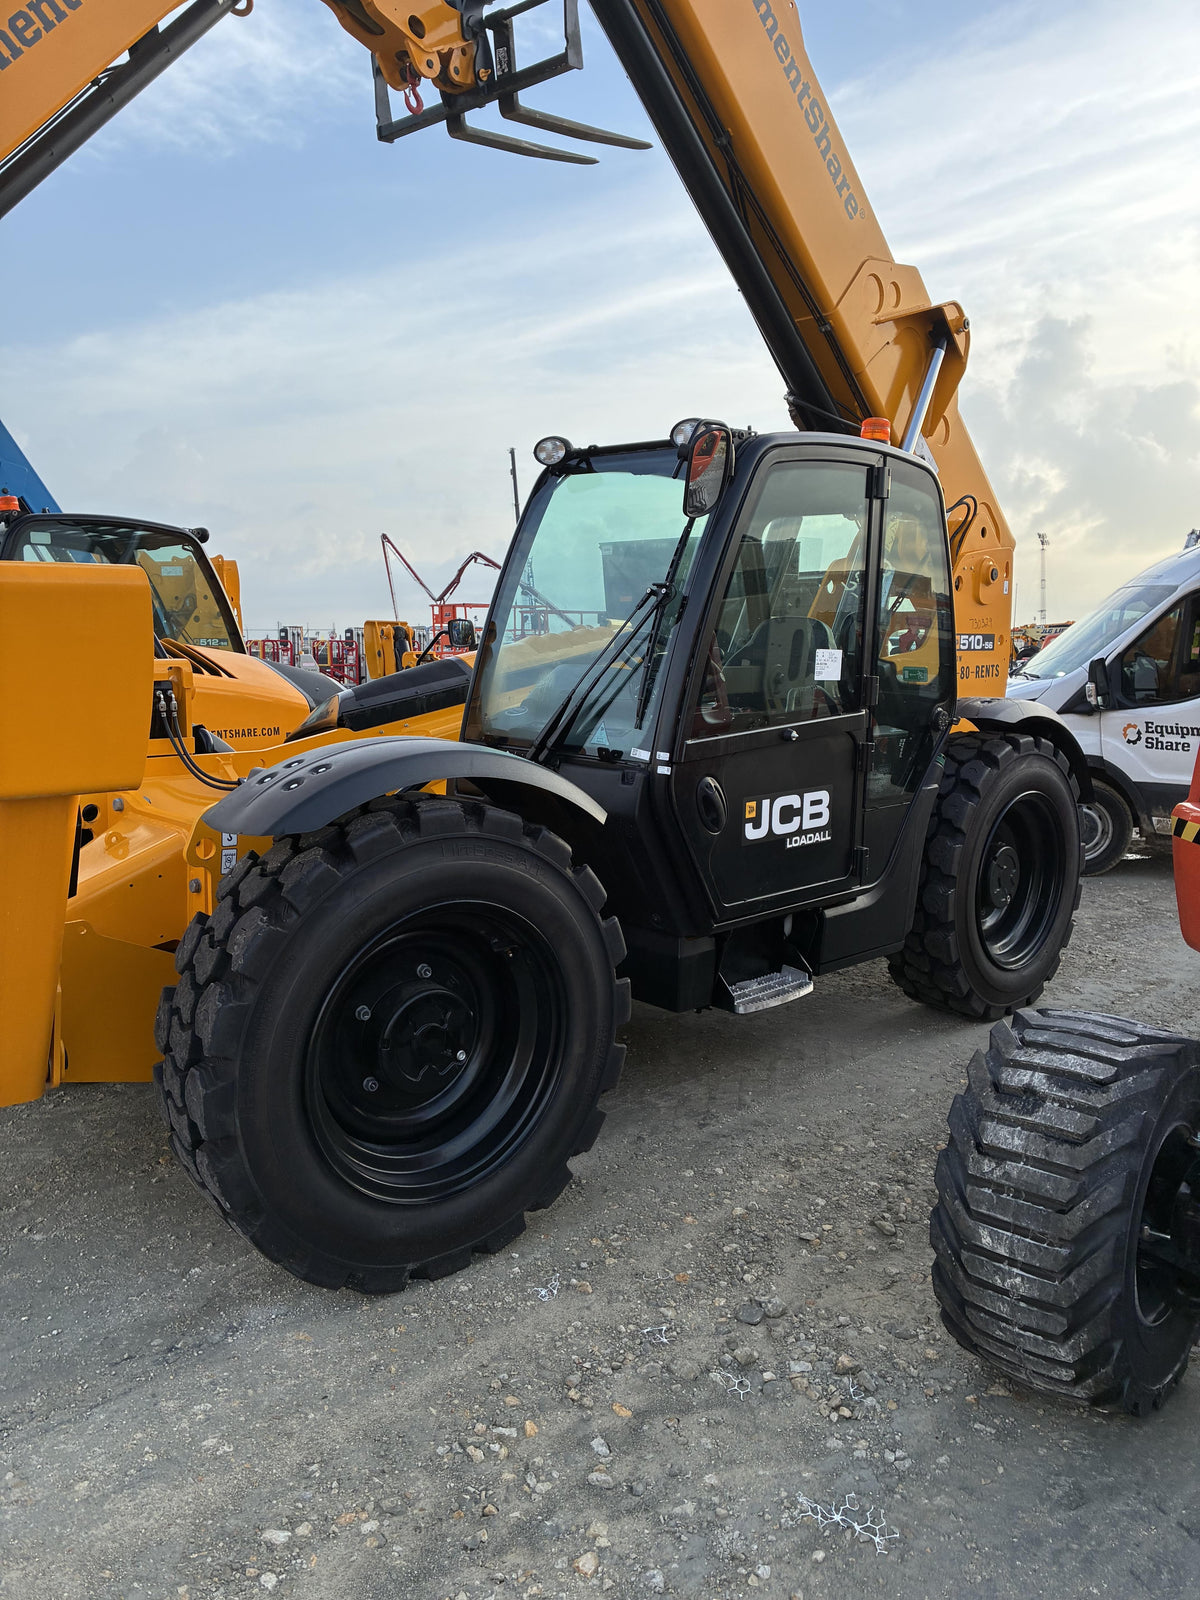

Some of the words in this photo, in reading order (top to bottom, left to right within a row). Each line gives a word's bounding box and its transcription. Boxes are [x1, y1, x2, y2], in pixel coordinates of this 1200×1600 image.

[0, 0, 83, 71] men
[1145, 736, 1191, 752] Share
[745, 790, 830, 840] JCB
[786, 830, 831, 848] LOADALL
